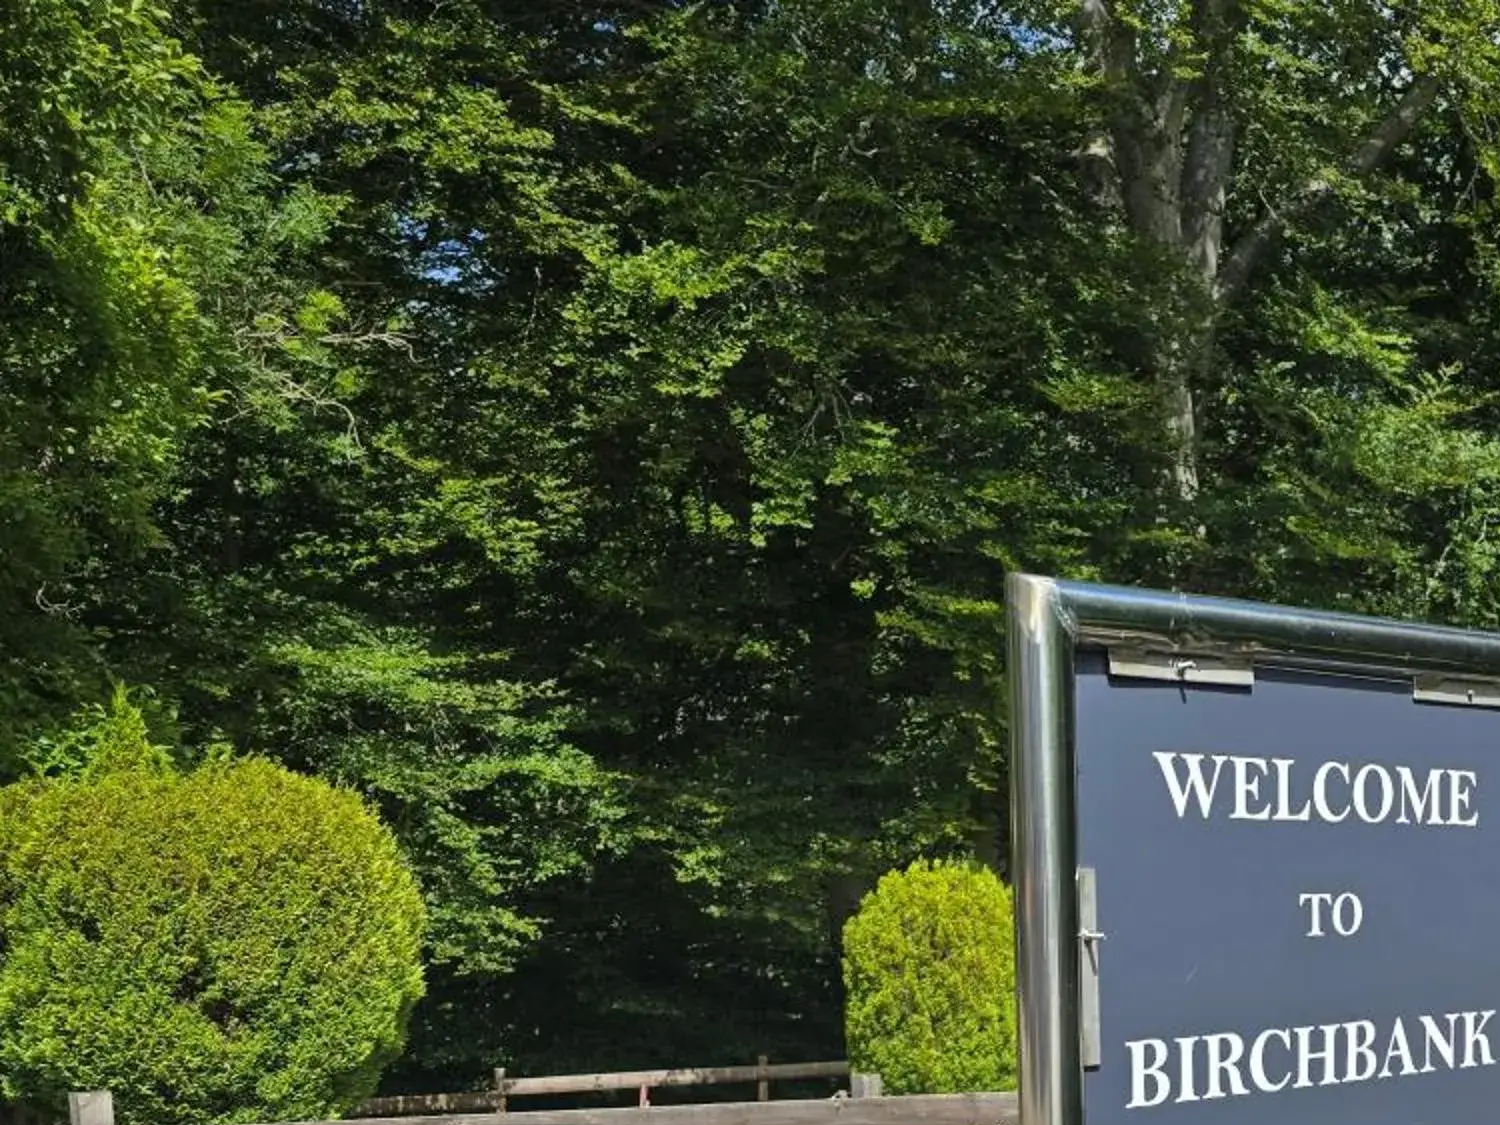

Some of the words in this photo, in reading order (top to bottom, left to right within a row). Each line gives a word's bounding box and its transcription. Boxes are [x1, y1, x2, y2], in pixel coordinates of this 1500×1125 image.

[1151, 751, 1480, 827] WELCOME
[1298, 892, 1364, 937] TO
[1124, 1009, 1497, 1109] BIRCHBANK
